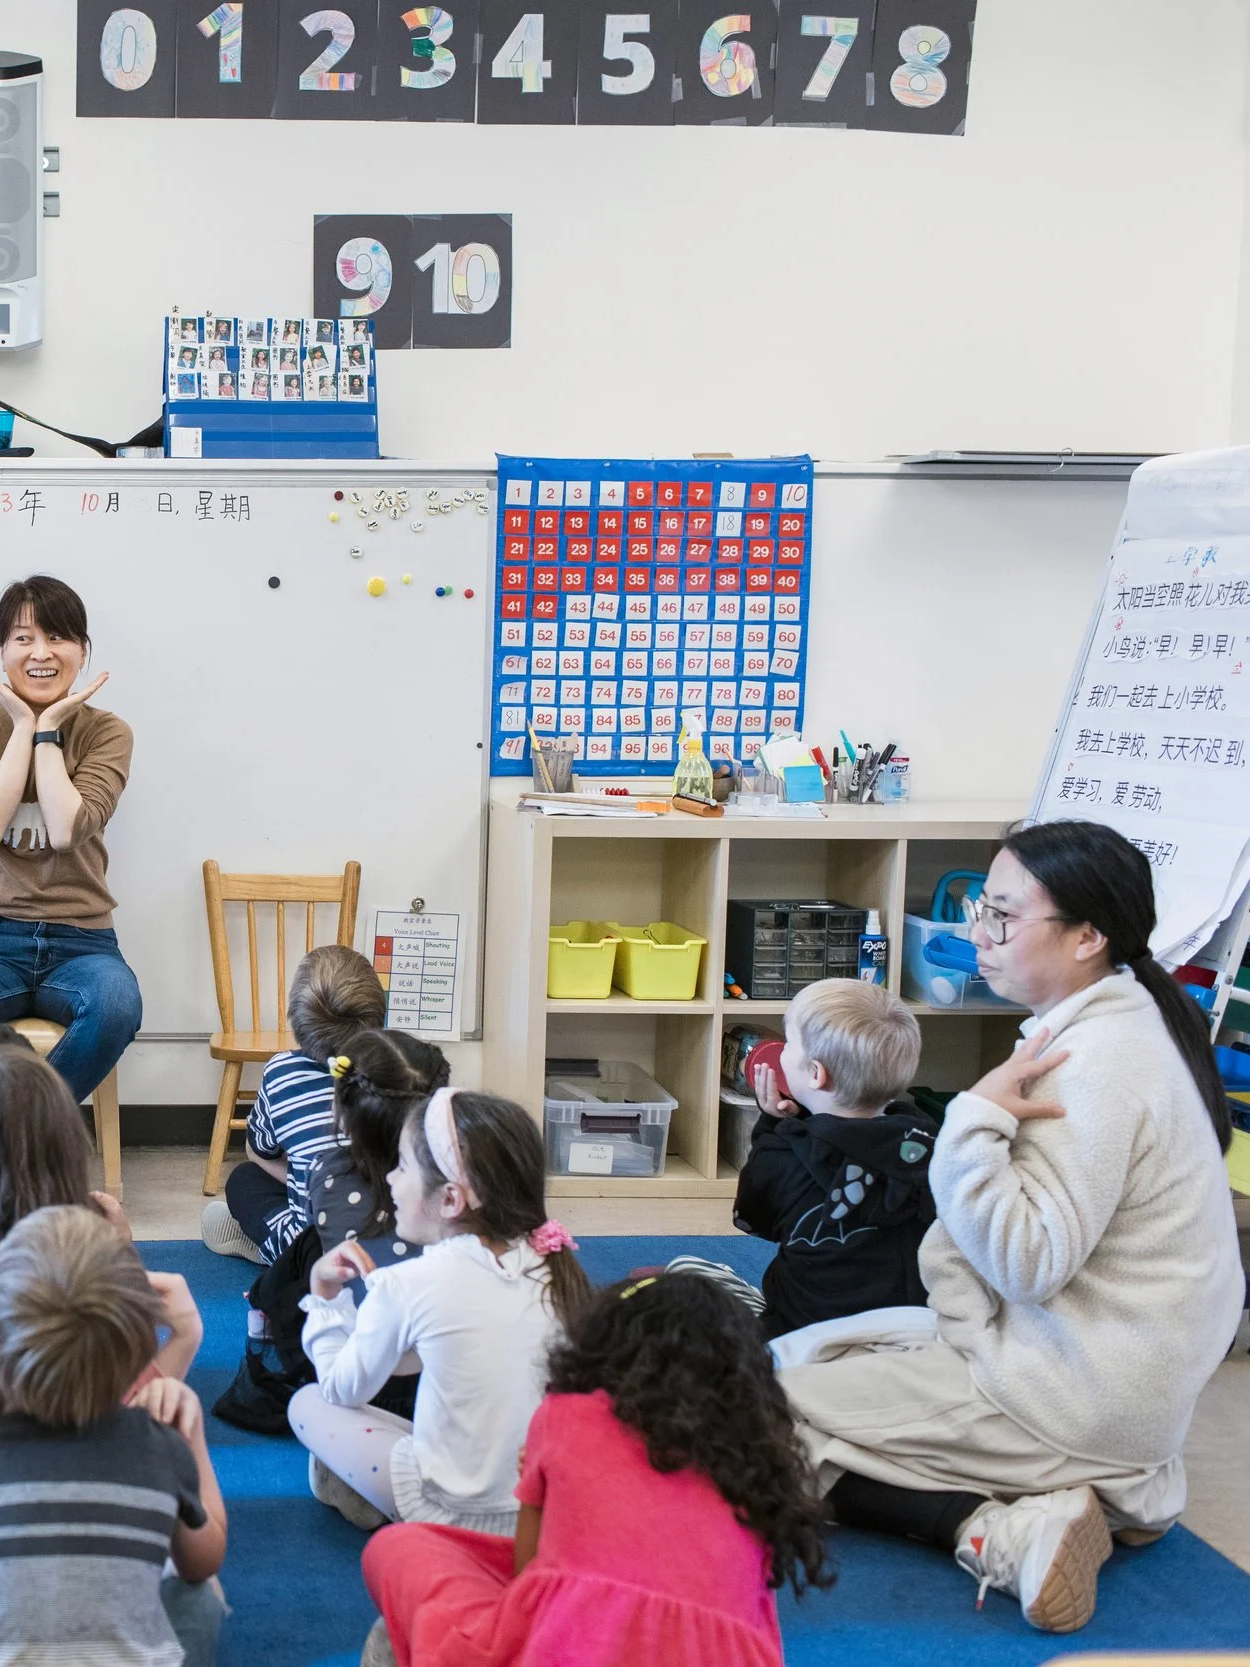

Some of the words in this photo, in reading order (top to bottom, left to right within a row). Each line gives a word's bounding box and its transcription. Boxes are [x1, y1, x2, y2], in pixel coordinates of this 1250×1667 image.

[99, 7, 157, 92] 0
[196, 2, 243, 83] 1
[298, 9, 356, 92] 2
[400, 6, 457, 91] 3
[491, 13, 552, 93] 4
[601, 14, 655, 95] 5
[699, 14, 751, 98] 6
[800, 15, 859, 98] 7
[889, 23, 949, 107] 8
[336, 237, 393, 317] 9
[415, 242, 501, 314] 10
[517, 488, 520, 497] 1
[547, 488, 554, 499] 2
[574, 489, 582, 499] 3
[608, 489, 616, 499] 4
[637, 488, 644, 499] 5
[665, 489, 673, 500] 6
[696, 489, 703, 499] 7
[727, 487, 735, 501] 8
[758, 490, 766, 501] 9
[787, 486, 805, 501] 10
[81, 492, 119, 515] 10月
[507, 601, 520, 611] 41
[537, 602, 553, 612] 42
[570, 603, 586, 613] 43
[598, 601, 613, 612] 44
[630, 603, 646, 613] 45
[662, 603, 677, 613] 46
[688, 603, 703, 613] 47
[719, 603, 735, 613] 48
[749, 604, 765, 614] 49
[779, 604, 795, 614] 50
[862, 941, 886, 953] EXPO
